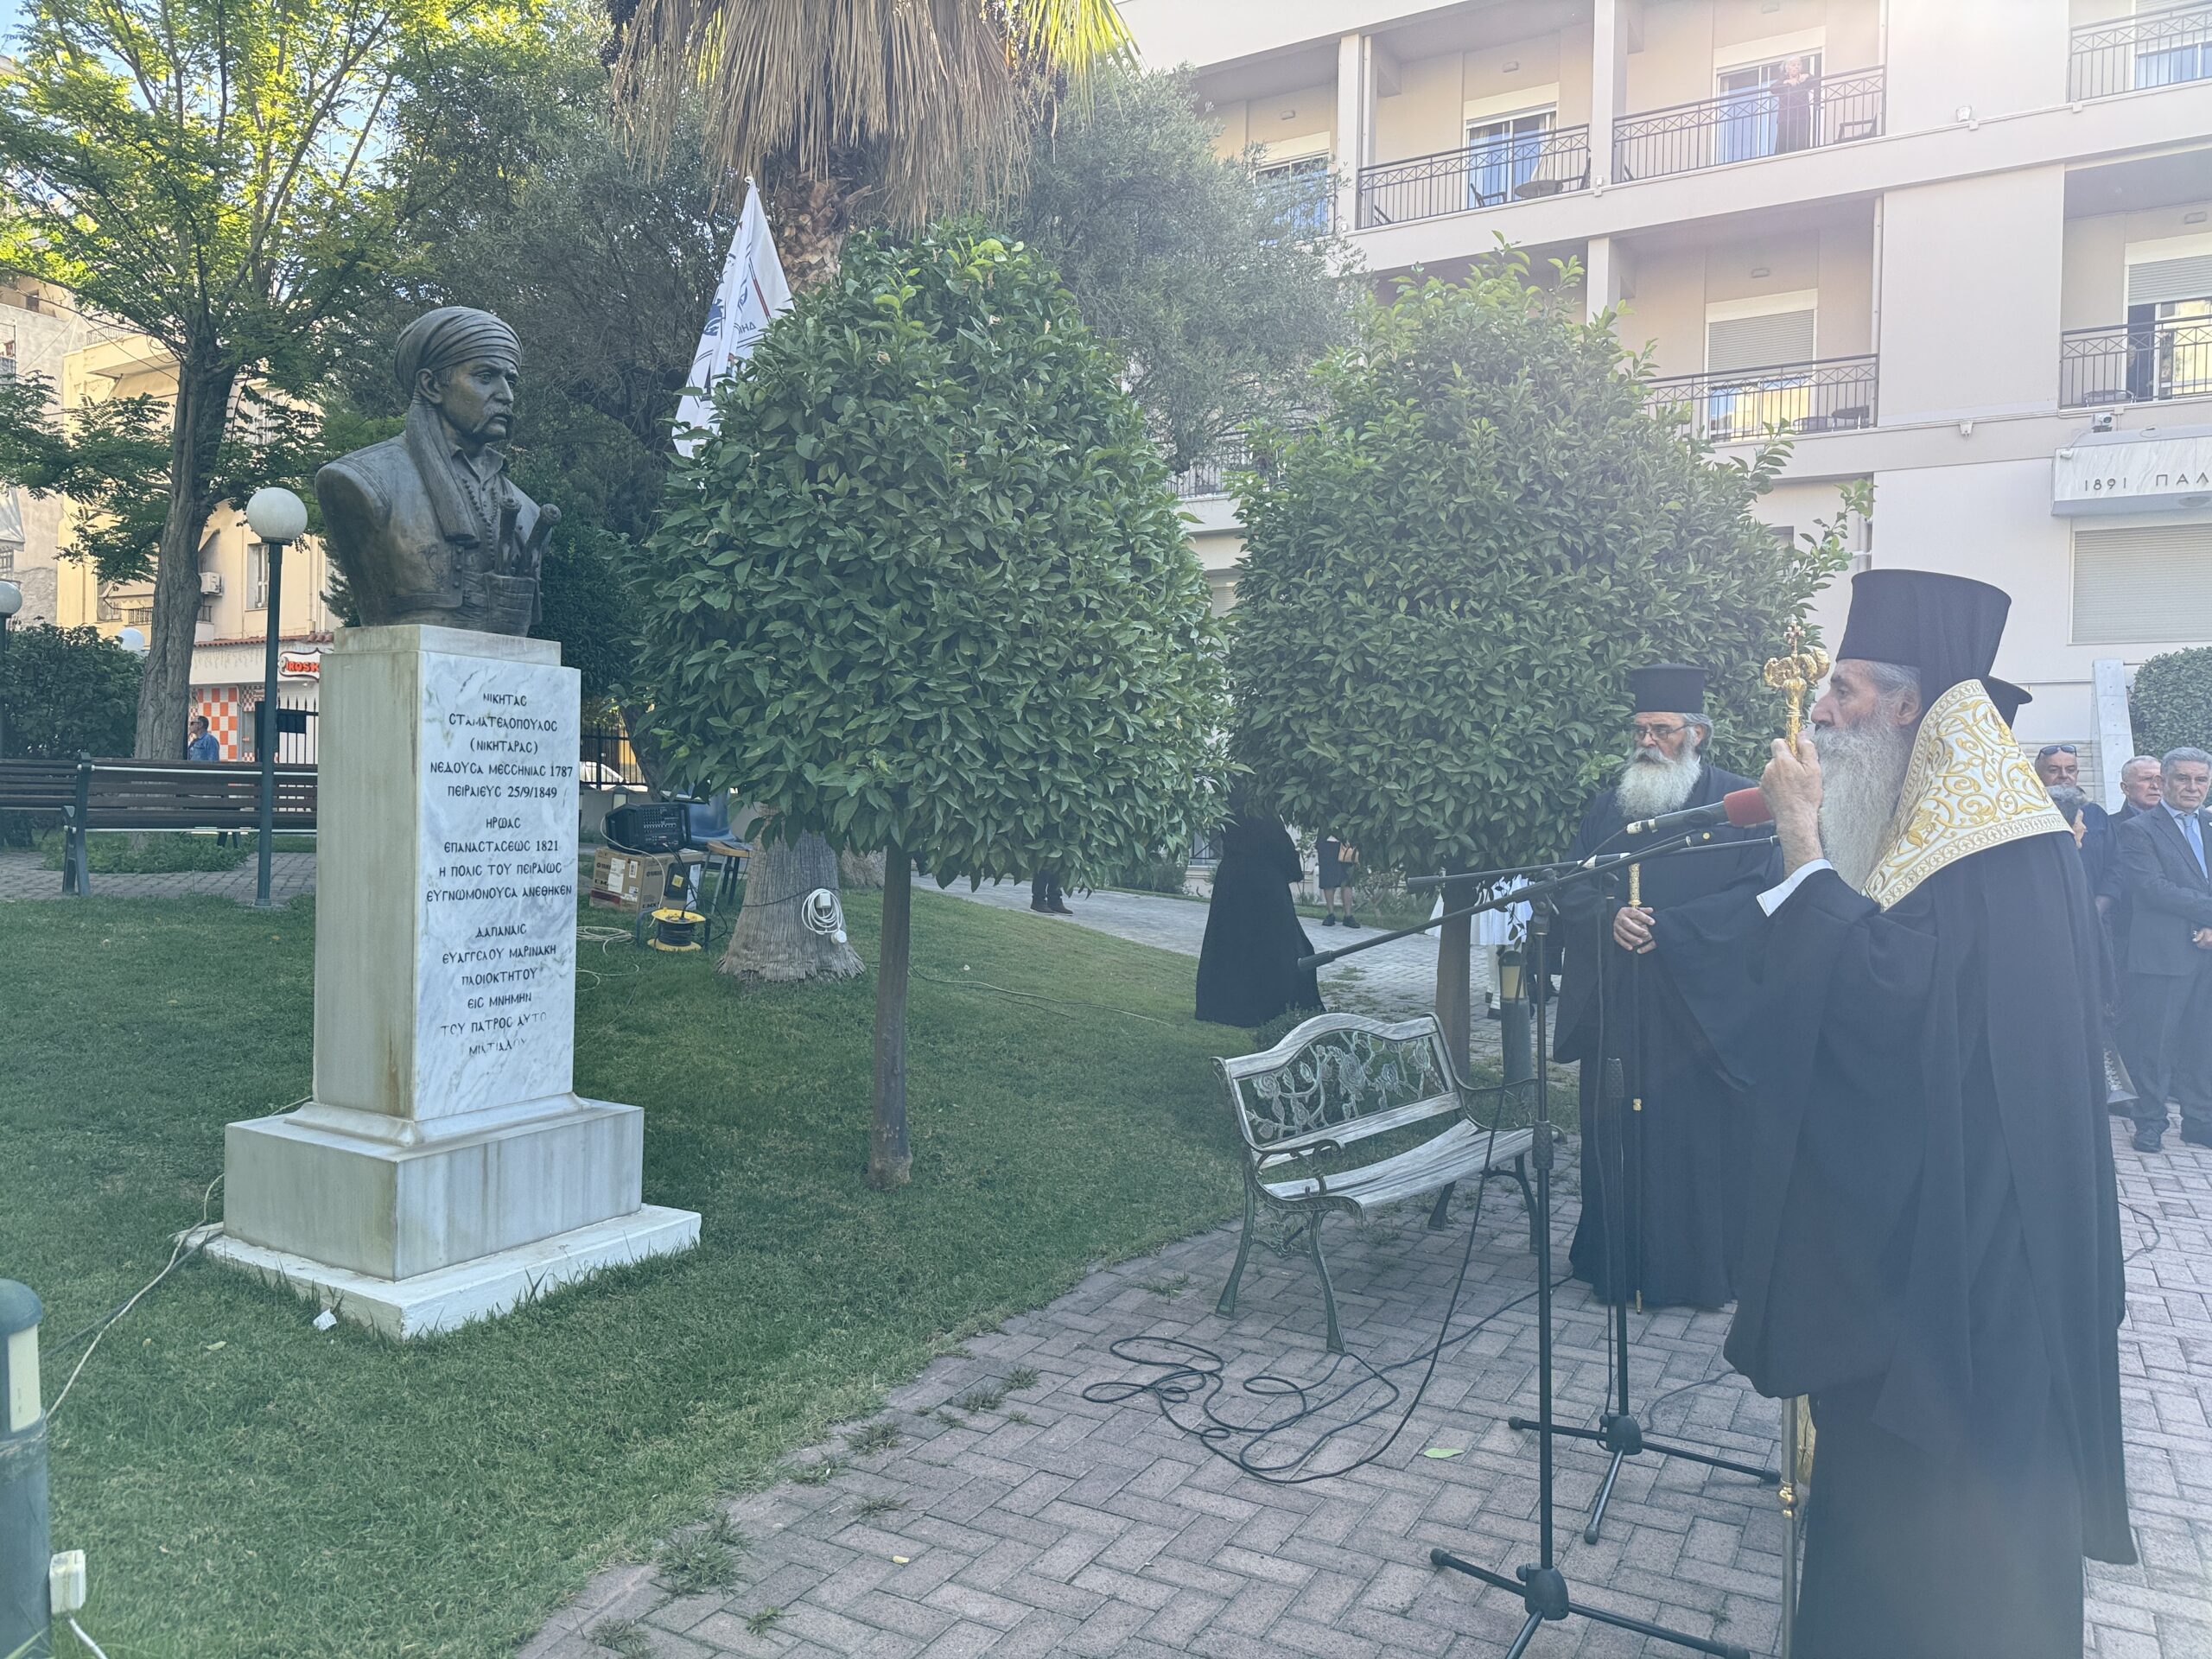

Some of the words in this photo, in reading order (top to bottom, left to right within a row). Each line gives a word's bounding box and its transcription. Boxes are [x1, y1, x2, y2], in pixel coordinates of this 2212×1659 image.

[2084, 477, 2126, 492] 1891
[550, 766, 573, 778] 1787
[507, 785, 557, 798] 25/9/1849
[536, 840, 558, 852] 1821
[439, 866, 446, 877] Η
[489, 863, 512, 875] ΤΟΥ
[489, 993, 532, 1007] ΜΝΗΜΗΝ
